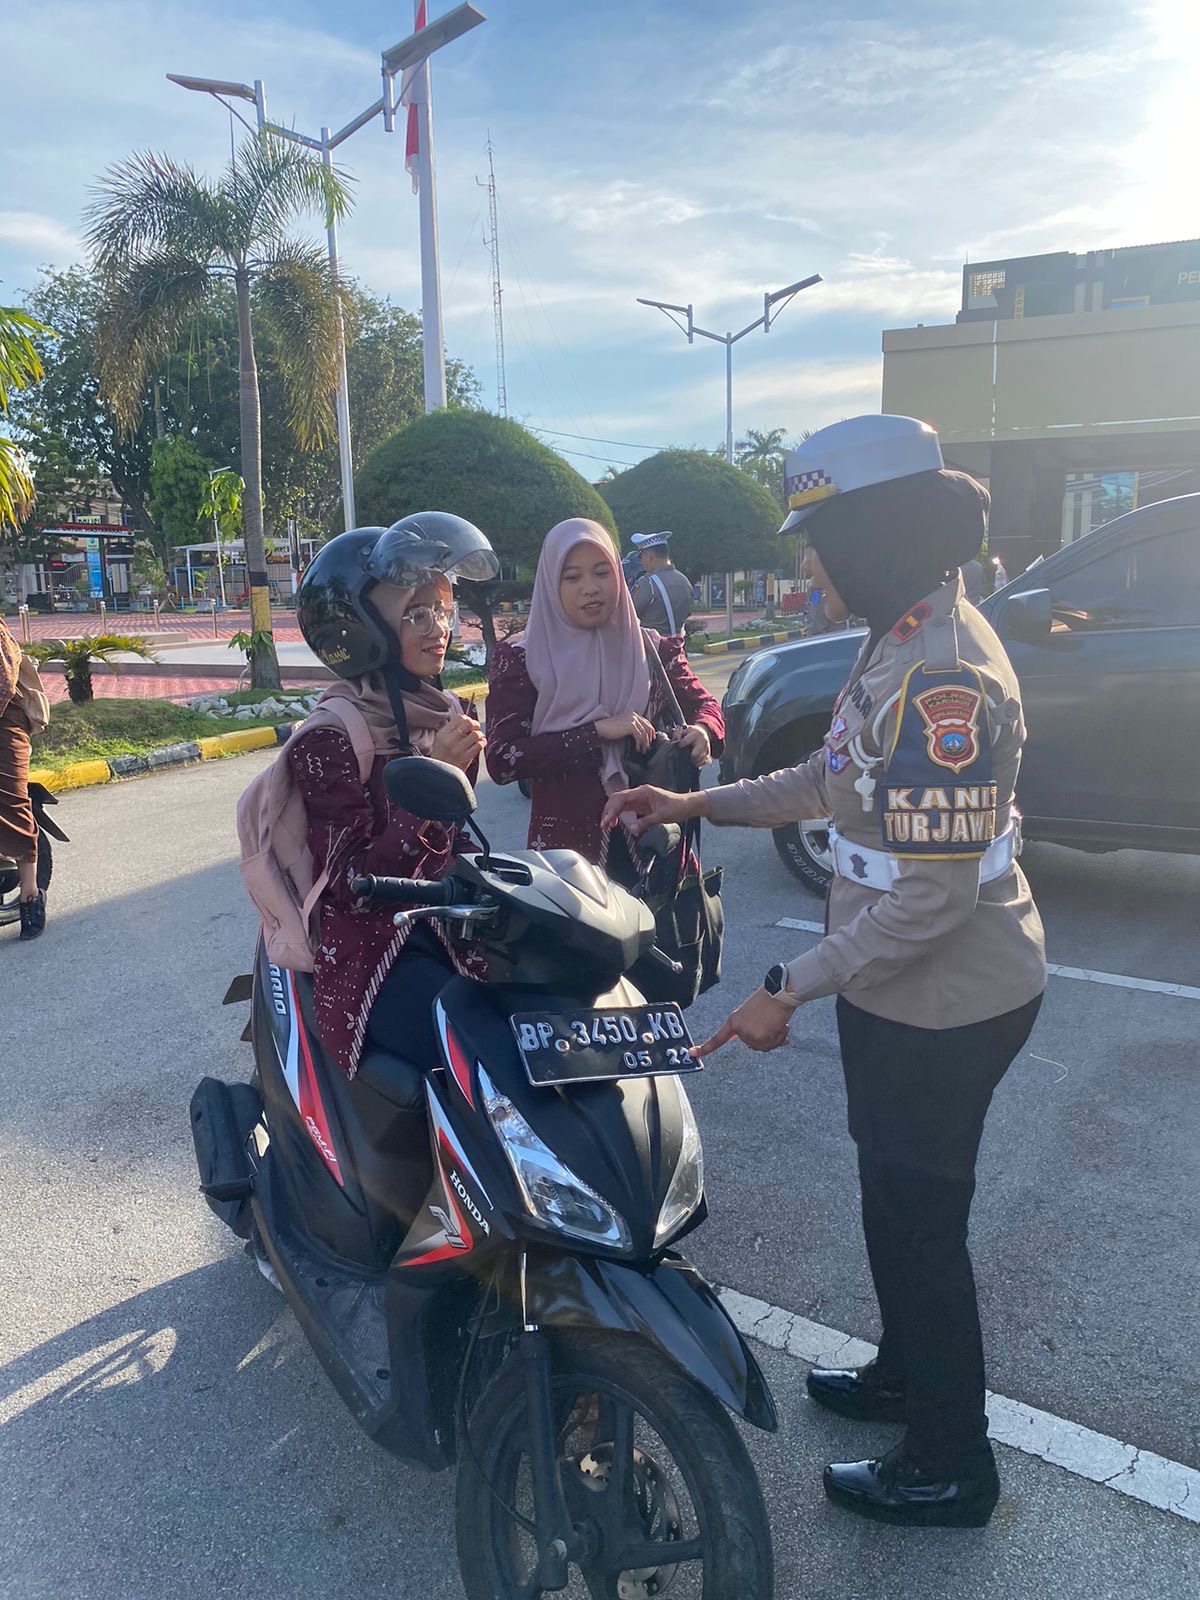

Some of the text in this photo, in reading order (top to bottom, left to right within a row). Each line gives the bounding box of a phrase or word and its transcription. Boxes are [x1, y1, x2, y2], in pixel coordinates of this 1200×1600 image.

[1178, 271, 1200, 285] PE
[269, 963, 286, 1016] ARIO
[519, 1012, 684, 1051] BP 3450 KB
[623, 1047, 693, 1069] 05 22
[450, 1170, 491, 1237] HONDA
